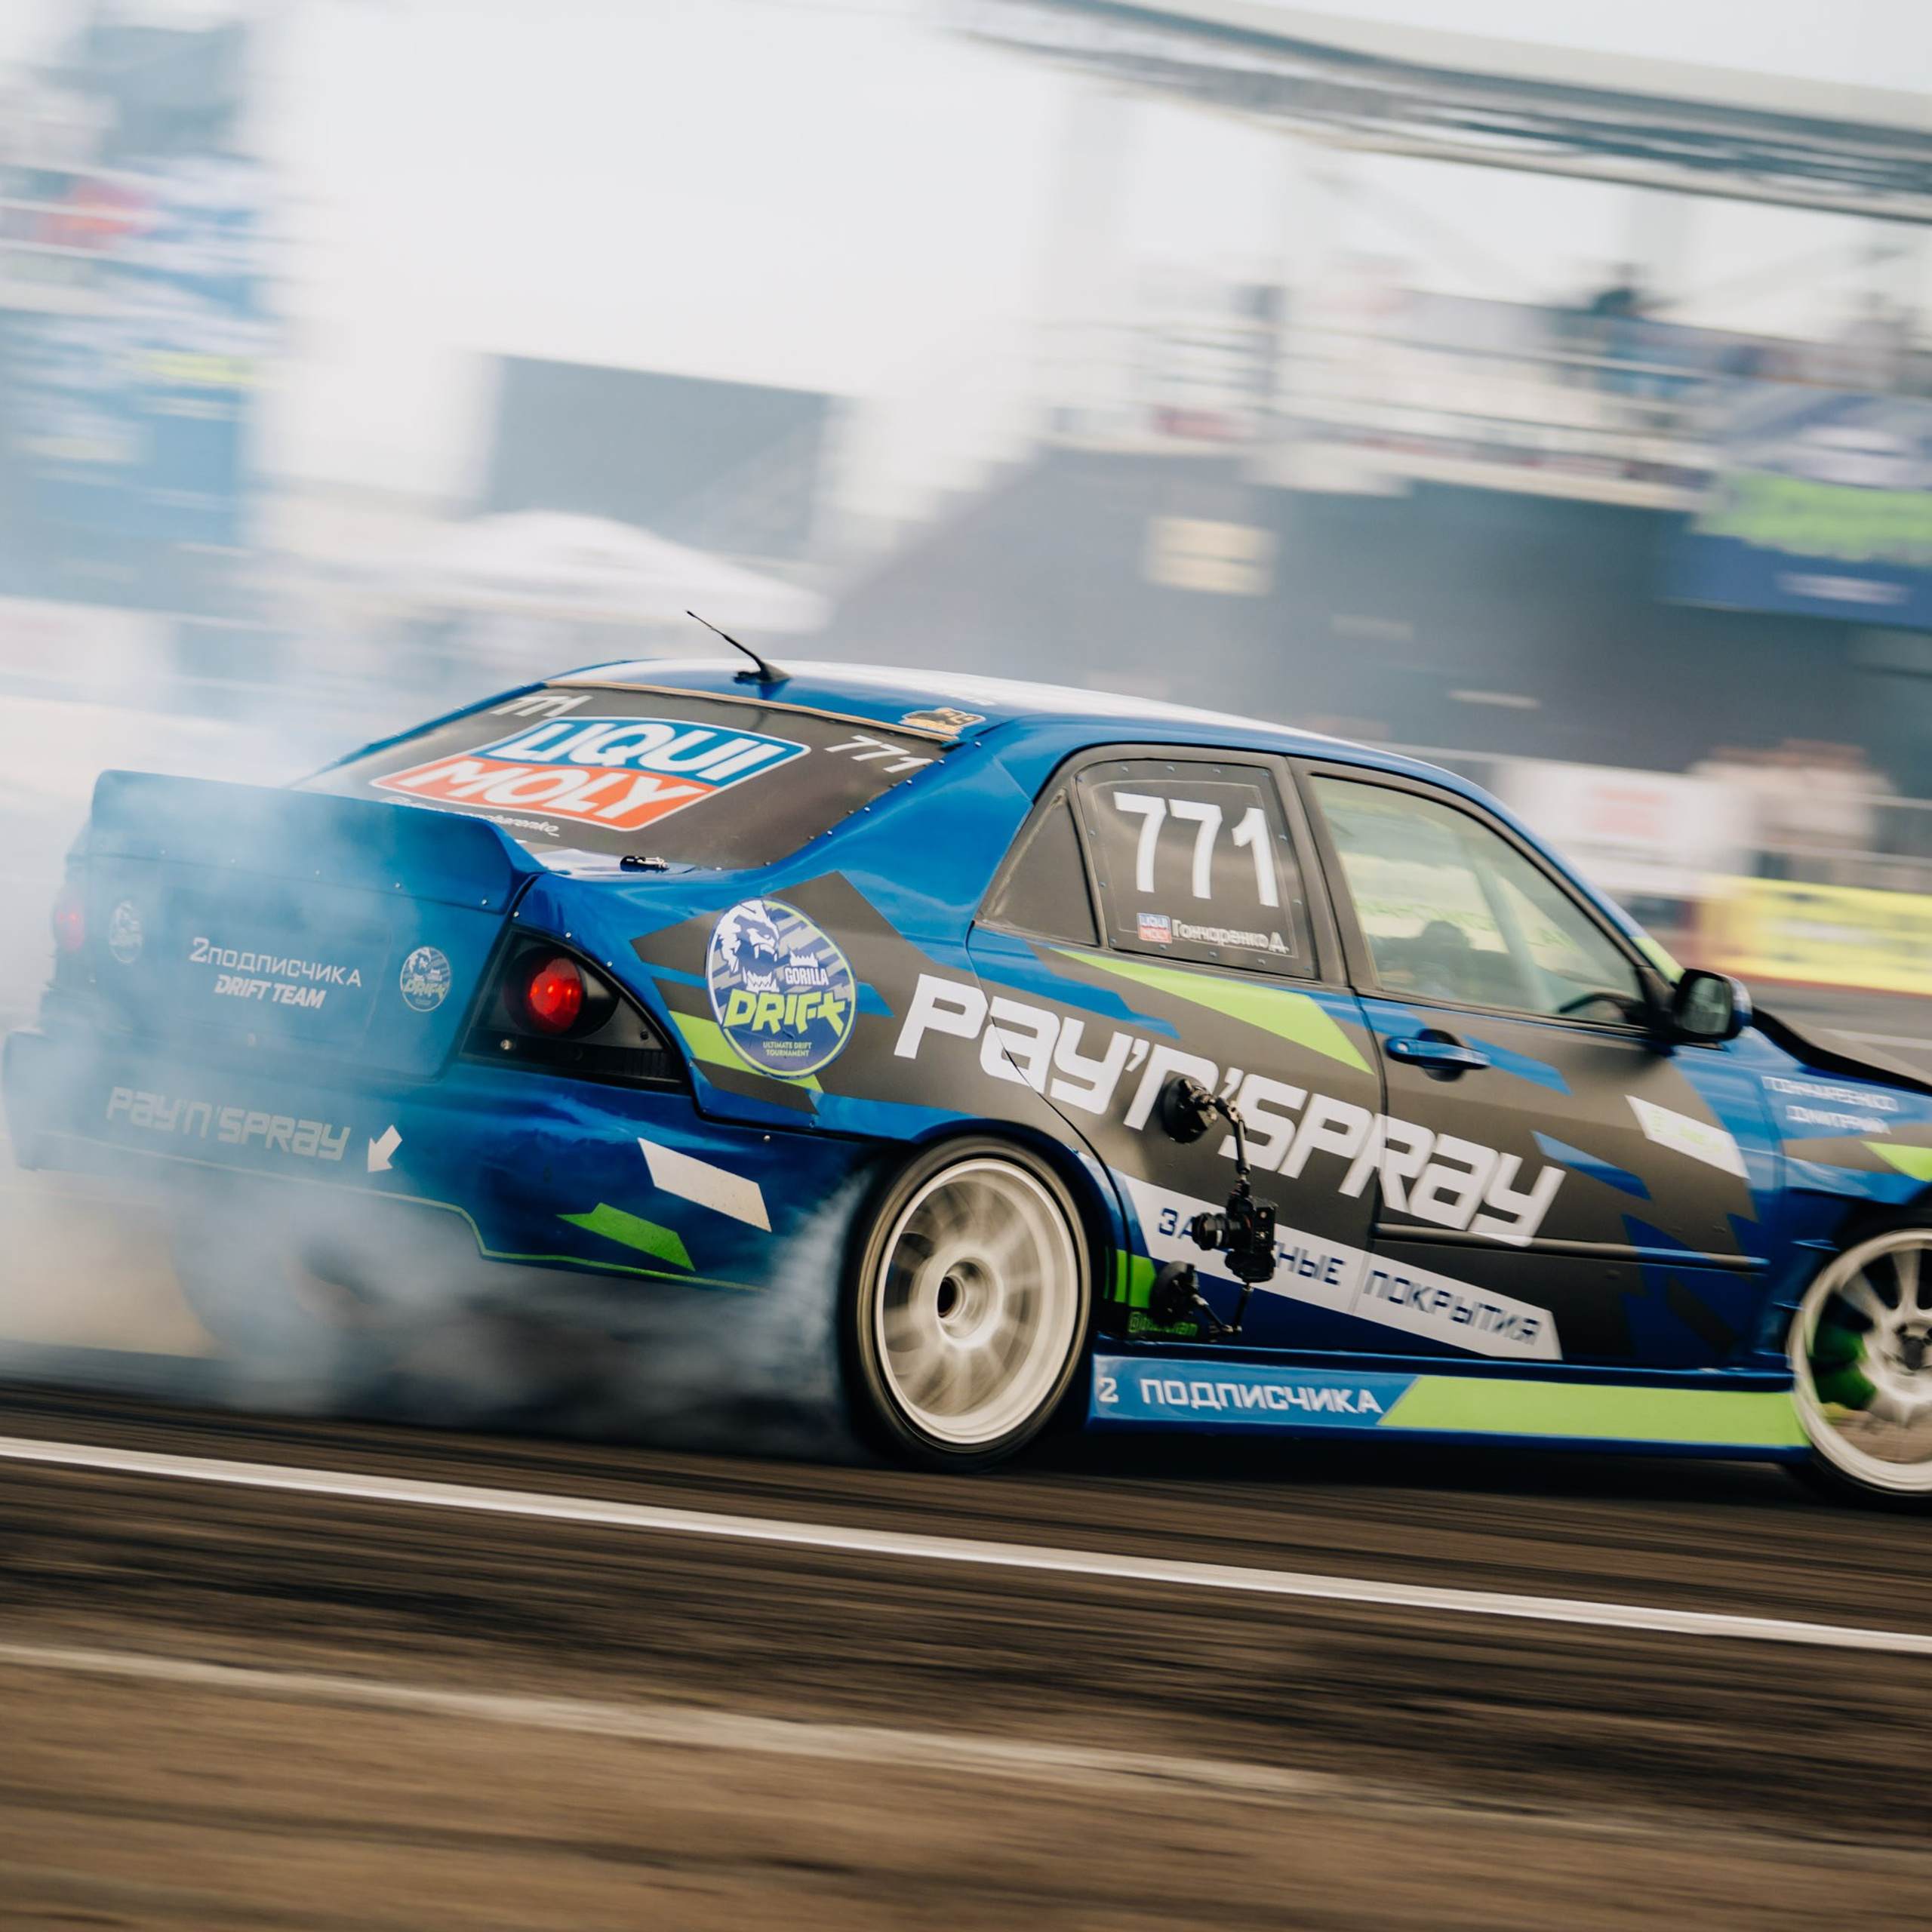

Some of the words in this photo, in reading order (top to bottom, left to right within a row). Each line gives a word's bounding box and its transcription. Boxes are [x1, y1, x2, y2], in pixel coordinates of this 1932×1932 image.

[485, 722, 786, 782] LIQUI
[824, 734, 934, 773] 771
[395, 761, 706, 817] MOLY
[1113, 791, 1279, 907] 771
[214, 974, 270, 1000] DRIFT
[272, 983, 327, 1009] TEAM
[785, 968, 829, 986] GORILLA
[723, 989, 846, 1038] DRIFT
[1158, 1208, 1346, 1286] ЗАНЫЕ
[1363, 1269, 1543, 1346] ПОКРЫТИЯ
[1097, 1377, 1120, 1403] 2
[1140, 1379, 1384, 1414] ПОДПИСЧИКА
